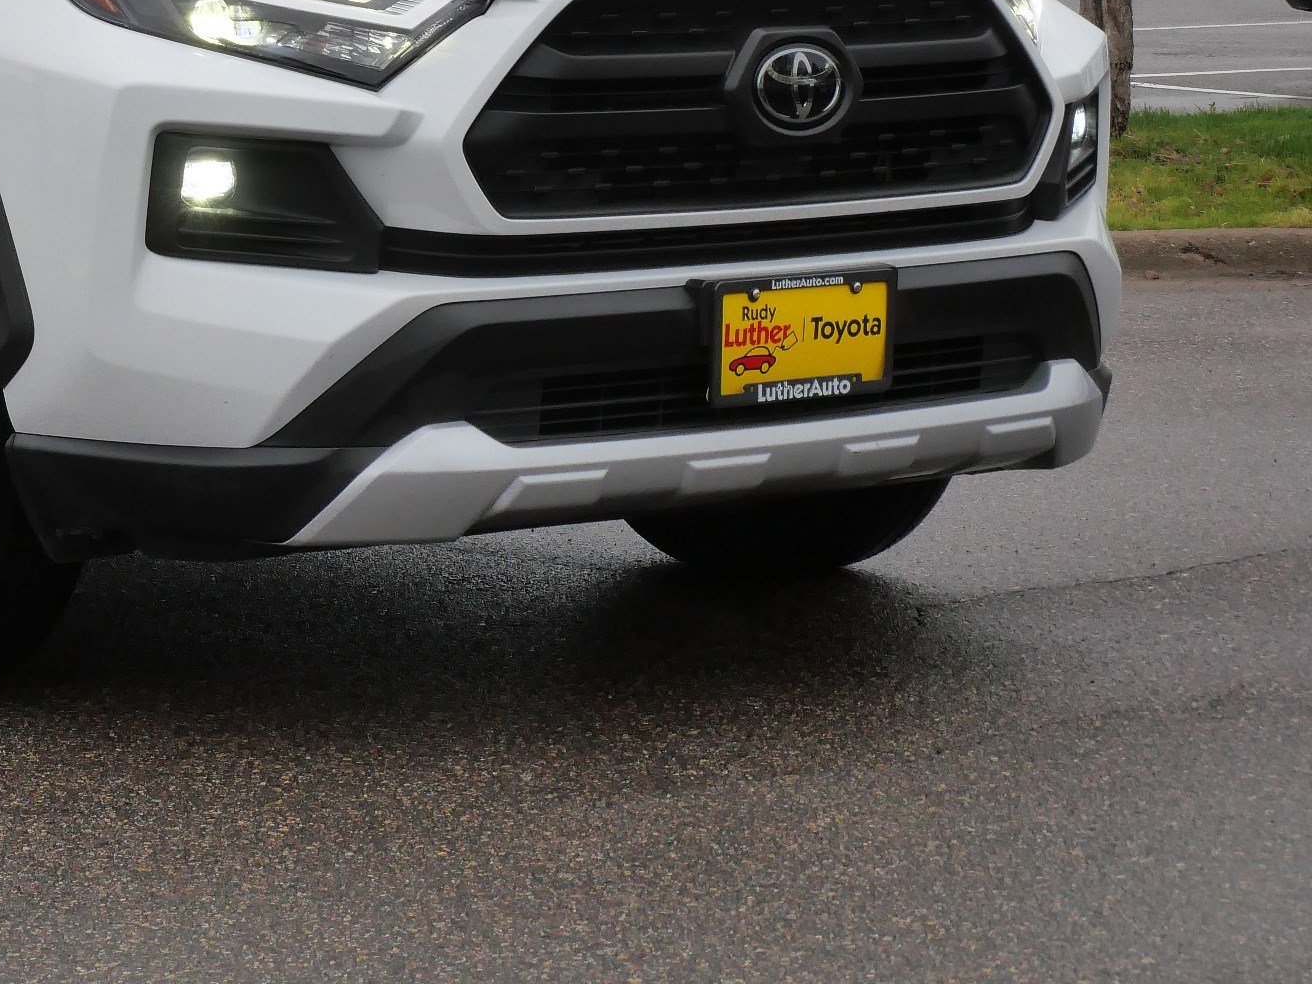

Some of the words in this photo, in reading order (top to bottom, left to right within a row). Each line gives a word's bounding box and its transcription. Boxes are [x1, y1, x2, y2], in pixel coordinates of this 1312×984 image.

[771, 276, 844, 290] LutherAuto.com
[741, 304, 777, 322] Rudy
[724, 321, 792, 348] Luther
[810, 314, 882, 345] Toyota
[757, 377, 851, 403] LutherAuto
